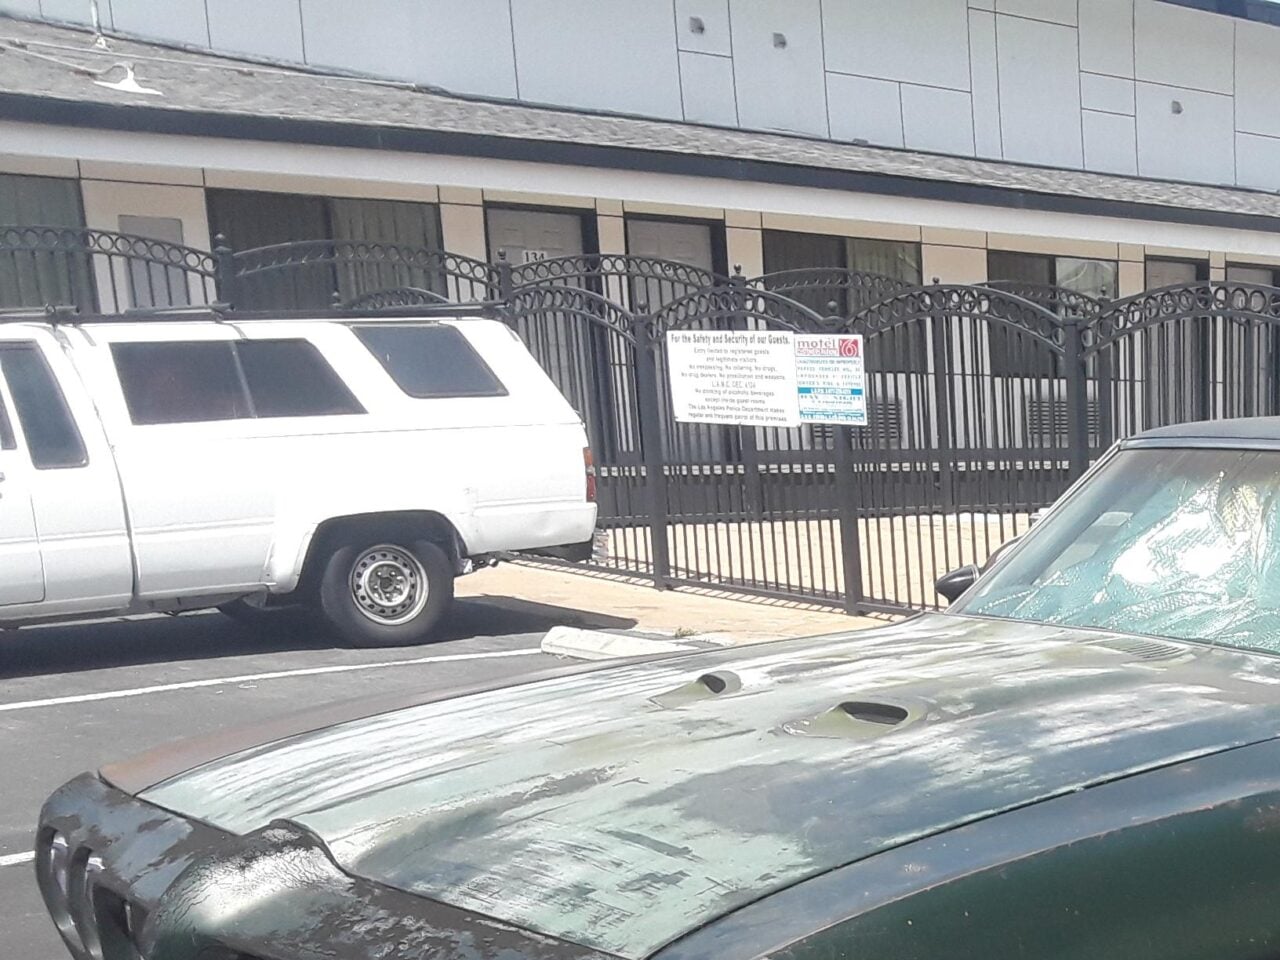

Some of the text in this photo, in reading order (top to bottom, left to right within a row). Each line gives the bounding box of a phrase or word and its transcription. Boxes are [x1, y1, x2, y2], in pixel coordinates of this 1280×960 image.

[671, 334, 680, 343] For
[682, 334, 691, 343] the
[693, 334, 710, 345] Safety
[713, 335, 722, 343] and
[725, 335, 748, 346] Security
[750, 335, 756, 344] of
[768, 335, 790, 344] Guests.
[797, 339, 836, 348] motel
[841, 339, 858, 357] 6
